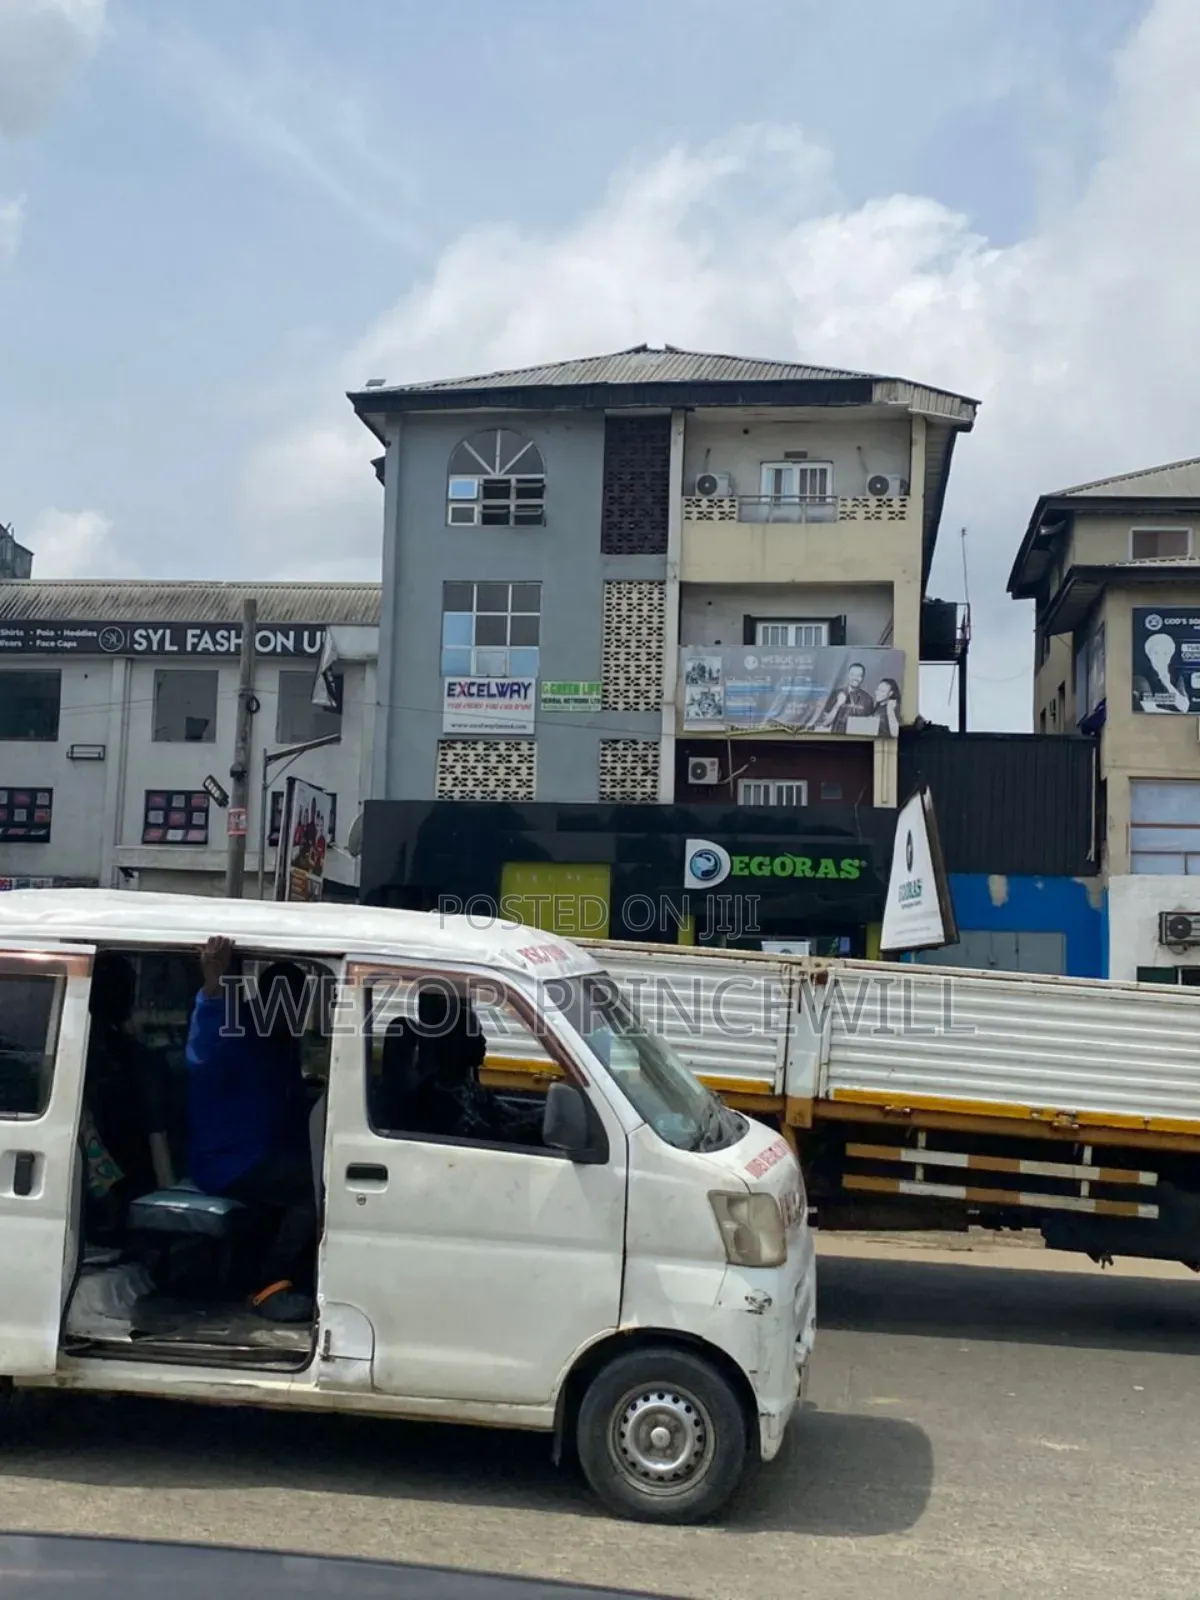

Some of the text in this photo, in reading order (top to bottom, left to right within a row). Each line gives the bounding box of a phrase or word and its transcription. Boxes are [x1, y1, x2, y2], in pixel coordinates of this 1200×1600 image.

[133, 629, 329, 653] SYL FASHON U
[447, 682, 532, 700] EXCELWAY
[731, 855, 860, 880] EGORAS
